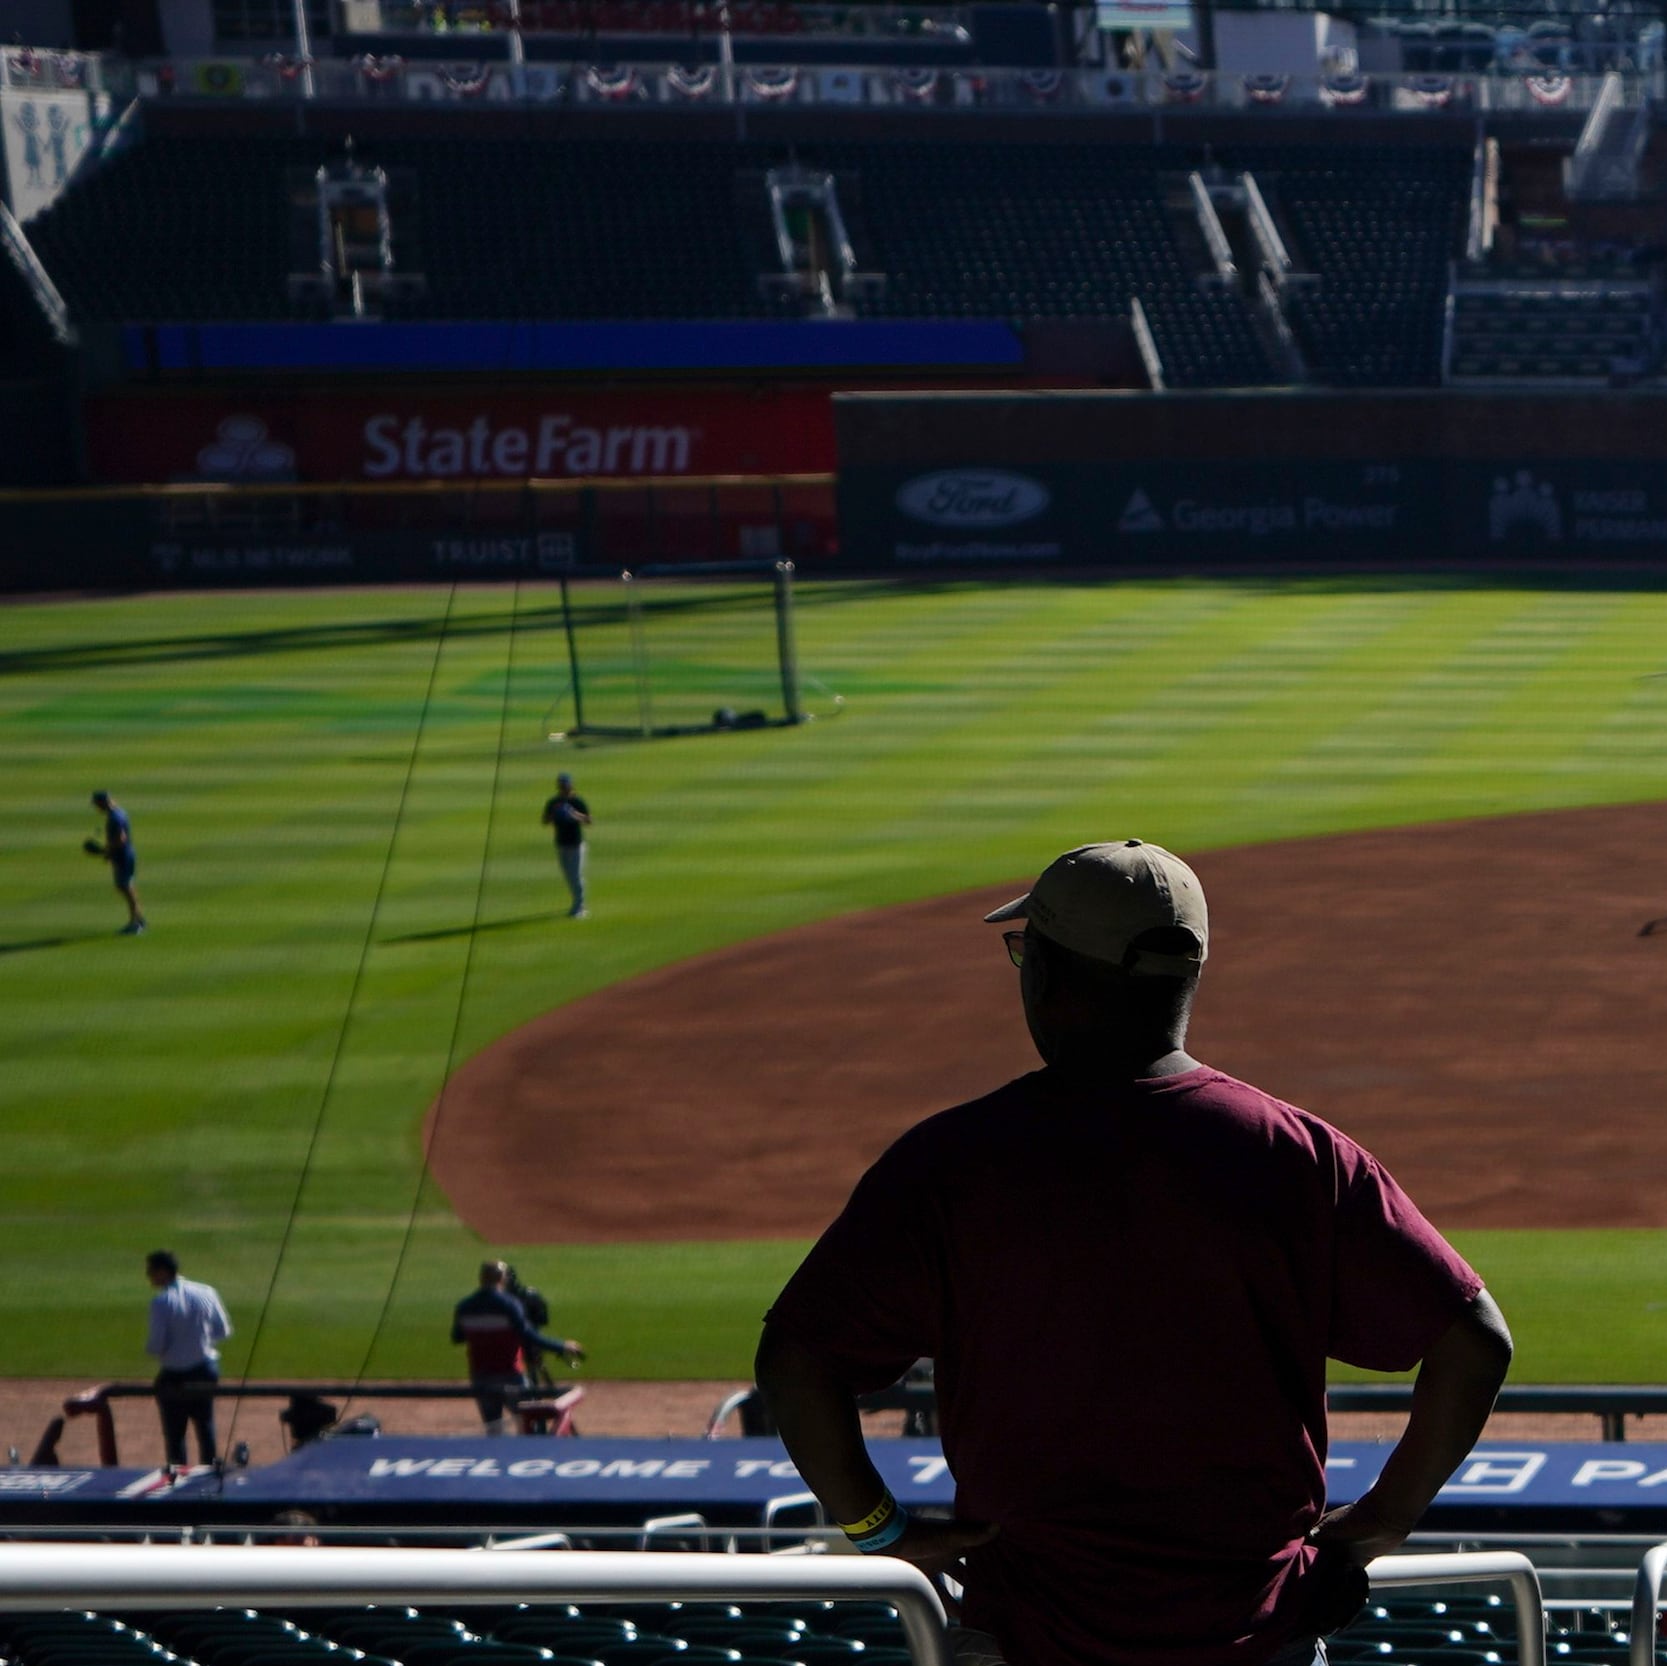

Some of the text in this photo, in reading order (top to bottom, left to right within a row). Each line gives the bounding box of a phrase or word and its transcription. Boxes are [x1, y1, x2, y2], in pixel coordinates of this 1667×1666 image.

[927, 477, 1020, 515] Ford
[1172, 497, 1400, 535] Georgia Power
[432, 538, 530, 562] TRUIST
[368, 1457, 713, 1479] WELCOME
